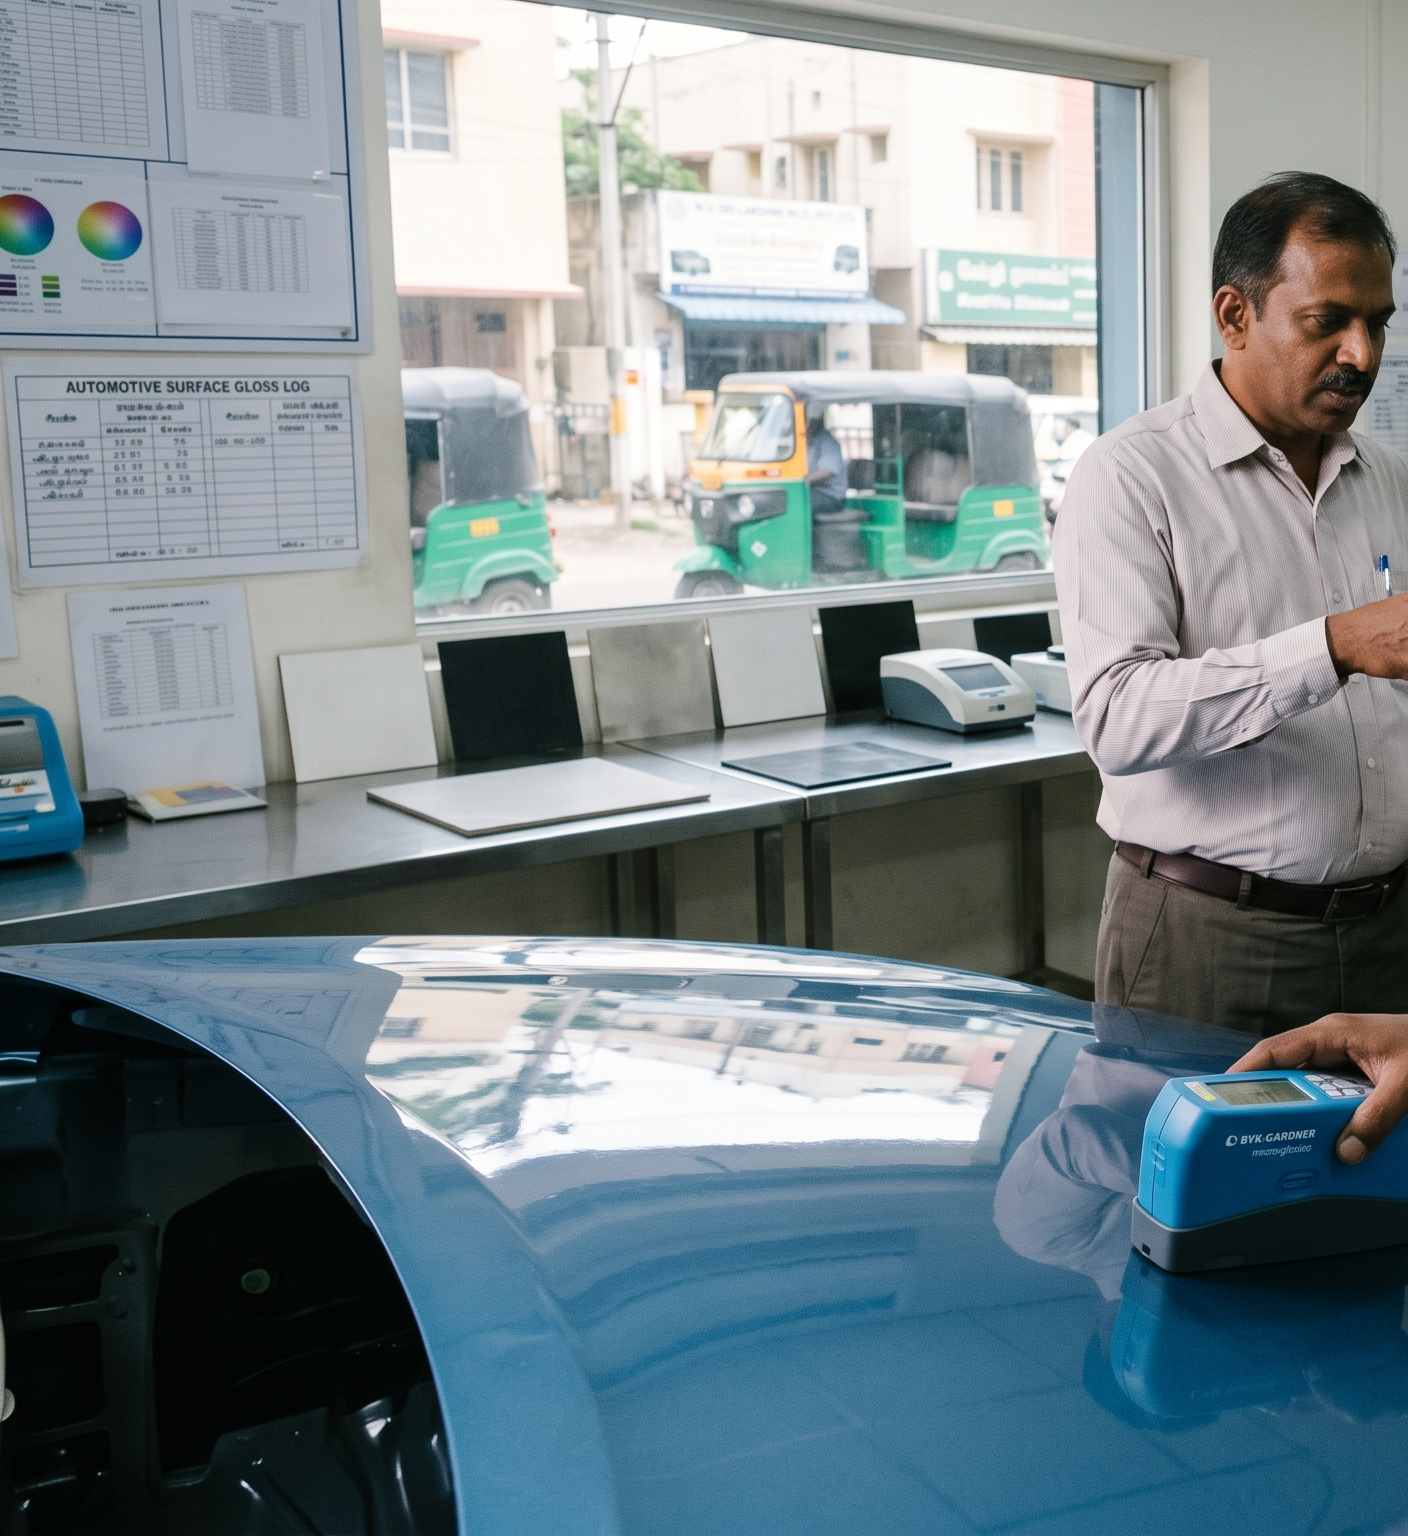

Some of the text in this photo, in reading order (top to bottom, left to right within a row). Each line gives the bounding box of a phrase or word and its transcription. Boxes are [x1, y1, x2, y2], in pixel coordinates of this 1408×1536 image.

[66, 380, 310, 394] AUTOMOTIVE SURFACE GLOSS LOG
